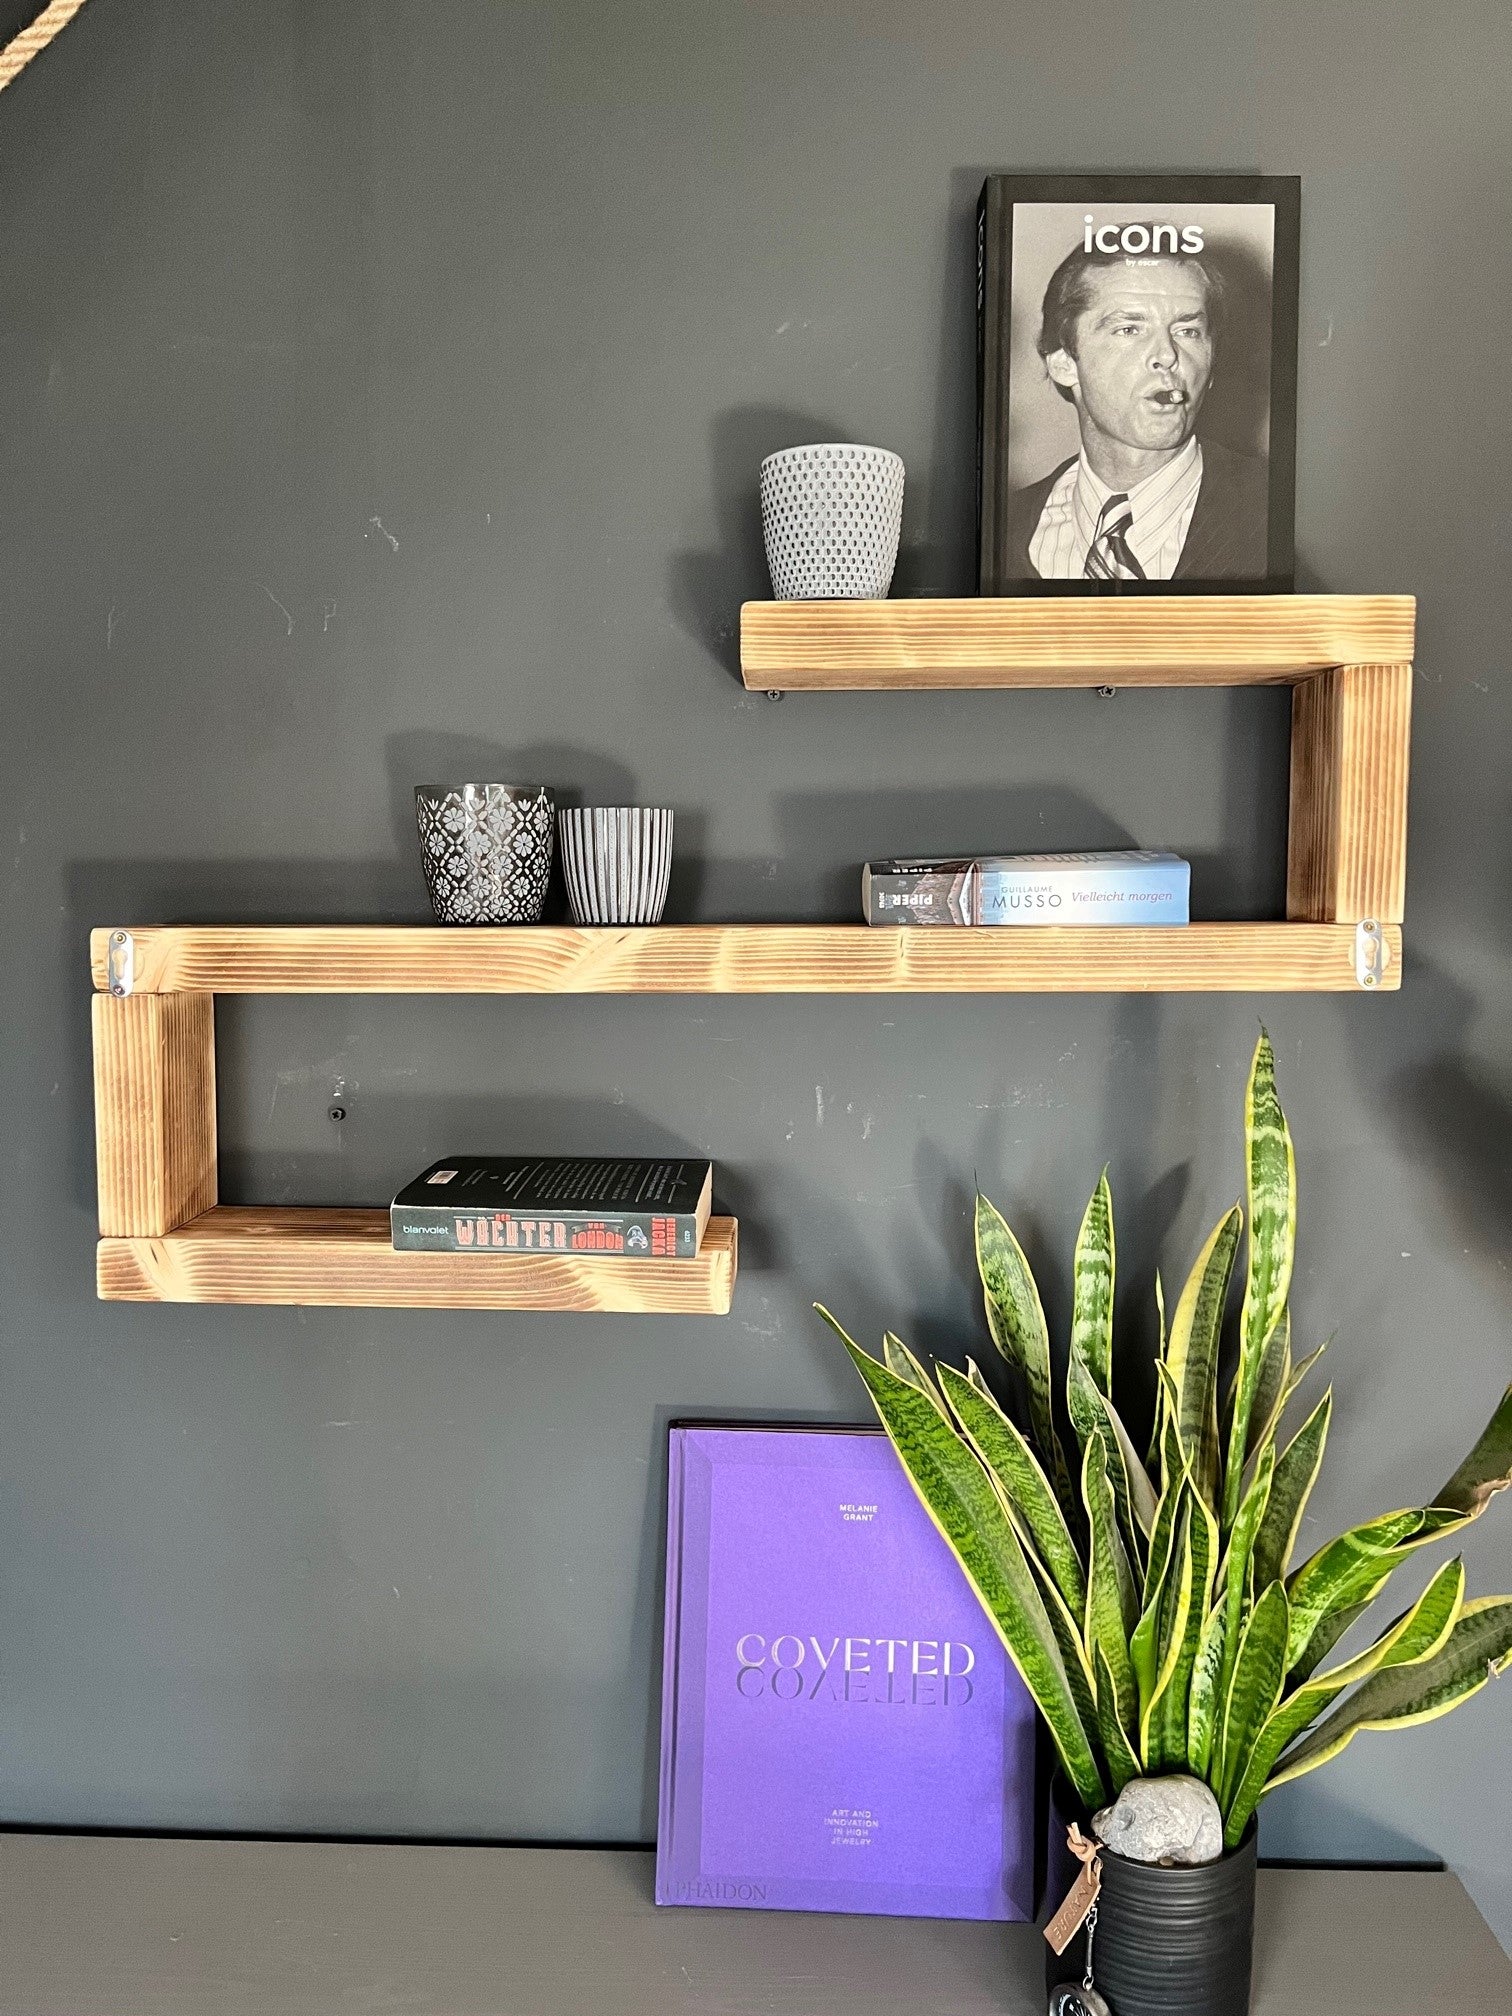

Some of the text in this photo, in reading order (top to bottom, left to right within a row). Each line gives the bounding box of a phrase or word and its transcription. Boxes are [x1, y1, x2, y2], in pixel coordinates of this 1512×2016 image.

[1084, 214, 1204, 254] icons
[1125, 259, 1136, 267] by
[893, 894, 932, 906] PIPER
[992, 895, 1062, 908] MUSSO
[1072, 892, 1172, 903] Vielleicht morgen
[403, 1225, 449, 1235] blanvalet
[456, 1216, 568, 1248] WÄCHTER
[571, 1230, 624, 1249] LONDON
[652, 1217, 665, 1256] JACKA
[840, 1504, 878, 1513] MELANIE
[843, 1513, 874, 1521] GRANT
[736, 1633, 975, 1677] COVETED
[832, 1809, 871, 1818] ART AND
[824, 1818, 879, 1827] INNOVATION
[846, 1828, 869, 1836] HIGH
[831, 1837, 871, 1845] JEWELRY
[676, 1881, 767, 1901] PHAIDON
